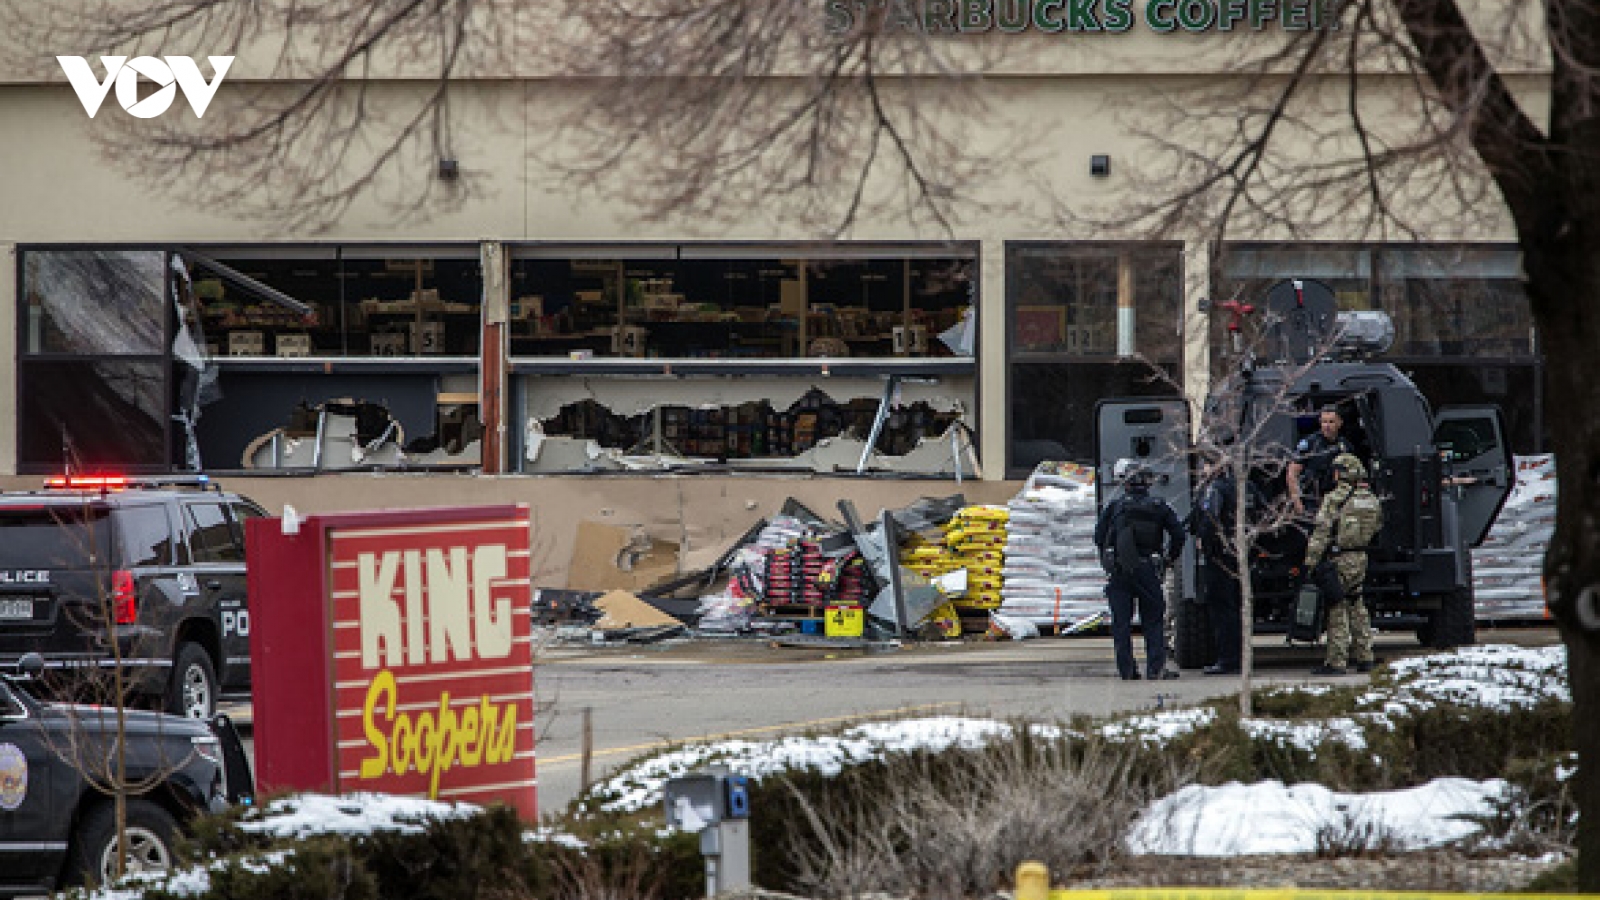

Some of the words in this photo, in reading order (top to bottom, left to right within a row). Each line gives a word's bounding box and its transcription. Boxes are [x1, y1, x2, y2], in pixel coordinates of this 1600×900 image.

[0, 570, 50, 582] LICE
[358, 544, 512, 669] KING
[360, 669, 517, 800] Soopers
